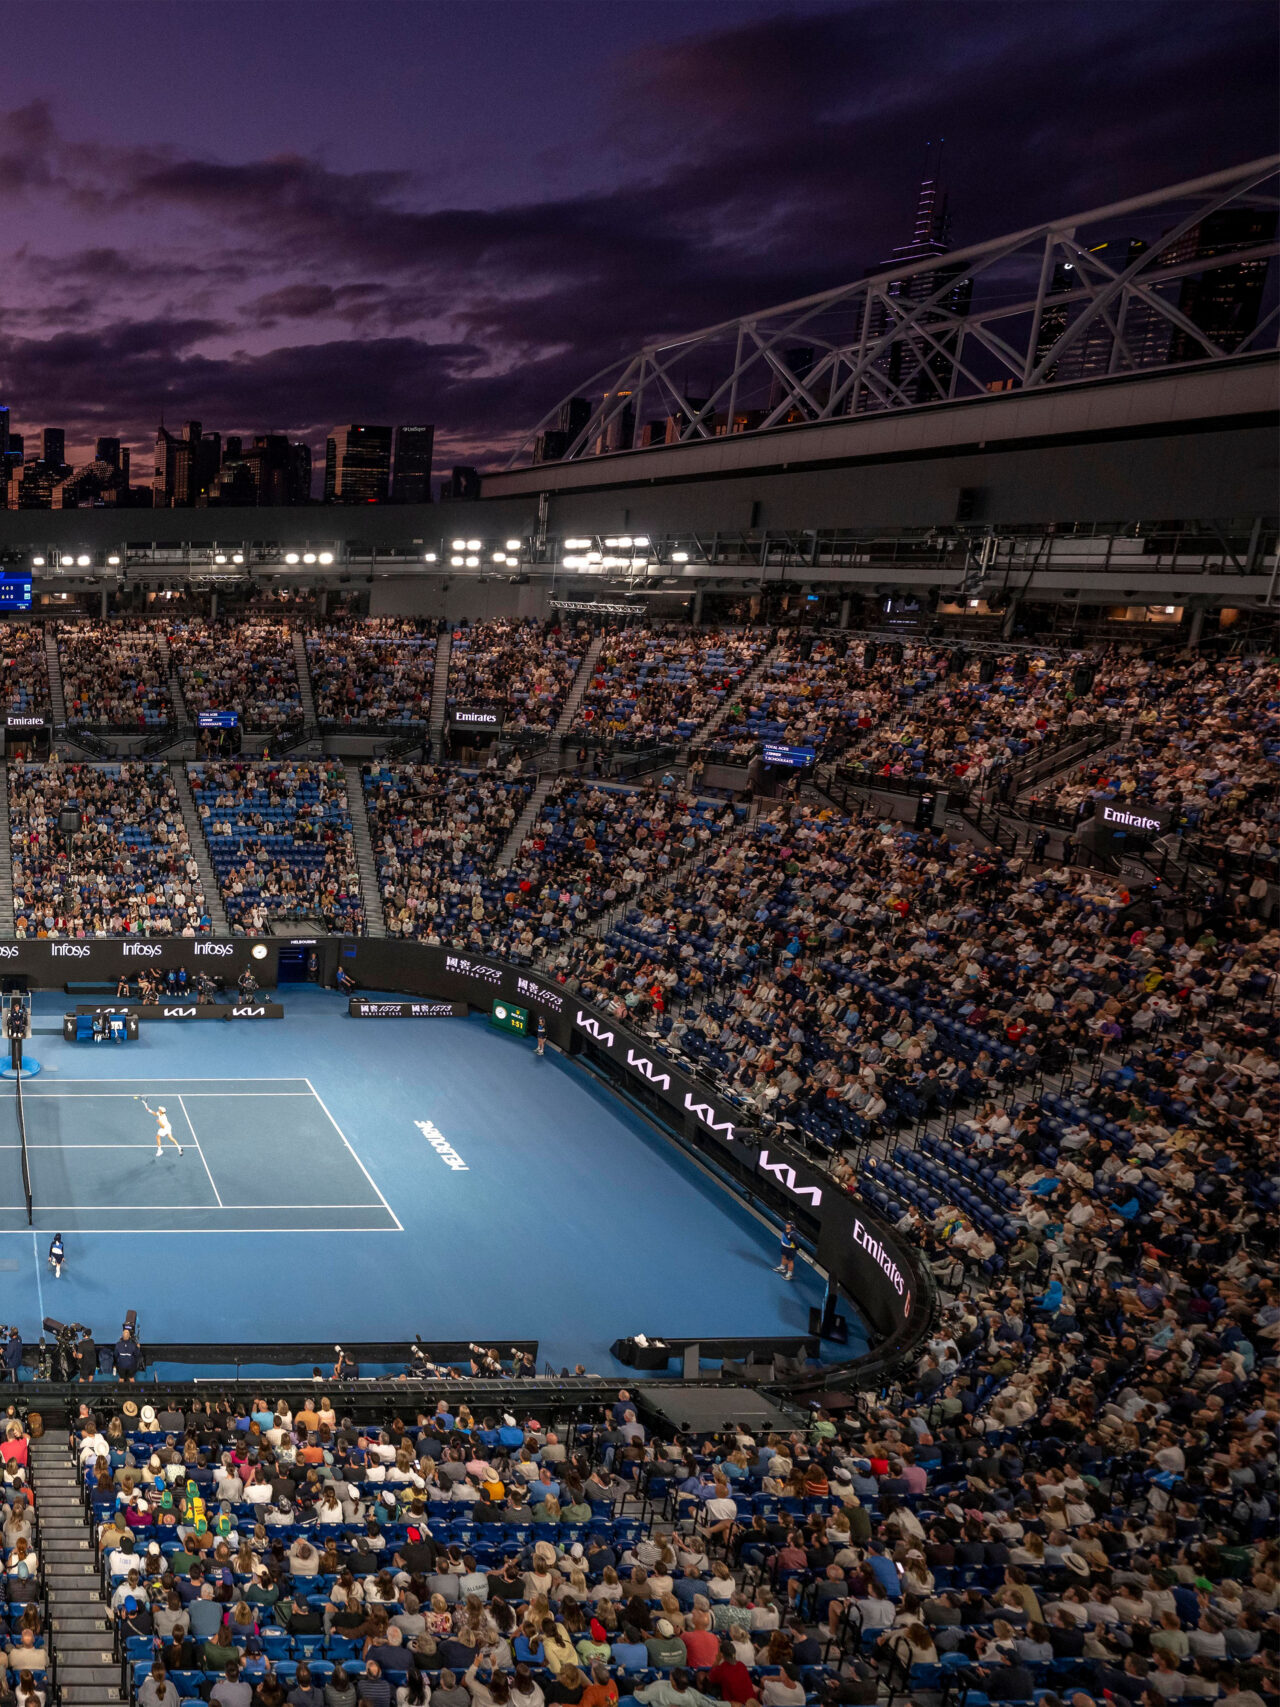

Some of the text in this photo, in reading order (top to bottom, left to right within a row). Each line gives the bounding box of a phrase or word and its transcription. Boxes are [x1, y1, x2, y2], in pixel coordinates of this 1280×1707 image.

[7, 717, 44, 726] Emirates
[456, 712, 497, 723] Emirates
[1103, 806, 1161, 831] Emirates
[51, 943, 90, 958] Infosys
[122, 942, 162, 958] Infosys
[194, 941, 234, 957] Infosys
[163, 1007, 197, 1017] KIA
[232, 1007, 265, 1016] KIA
[576, 1010, 614, 1047] KIA
[627, 1049, 670, 1091] KIA
[684, 1093, 735, 1140] KIA
[413, 1119, 470, 1171] MELBOURNE
[759, 1150, 822, 1206] KIA
[852, 1217, 905, 1296] Emirates
